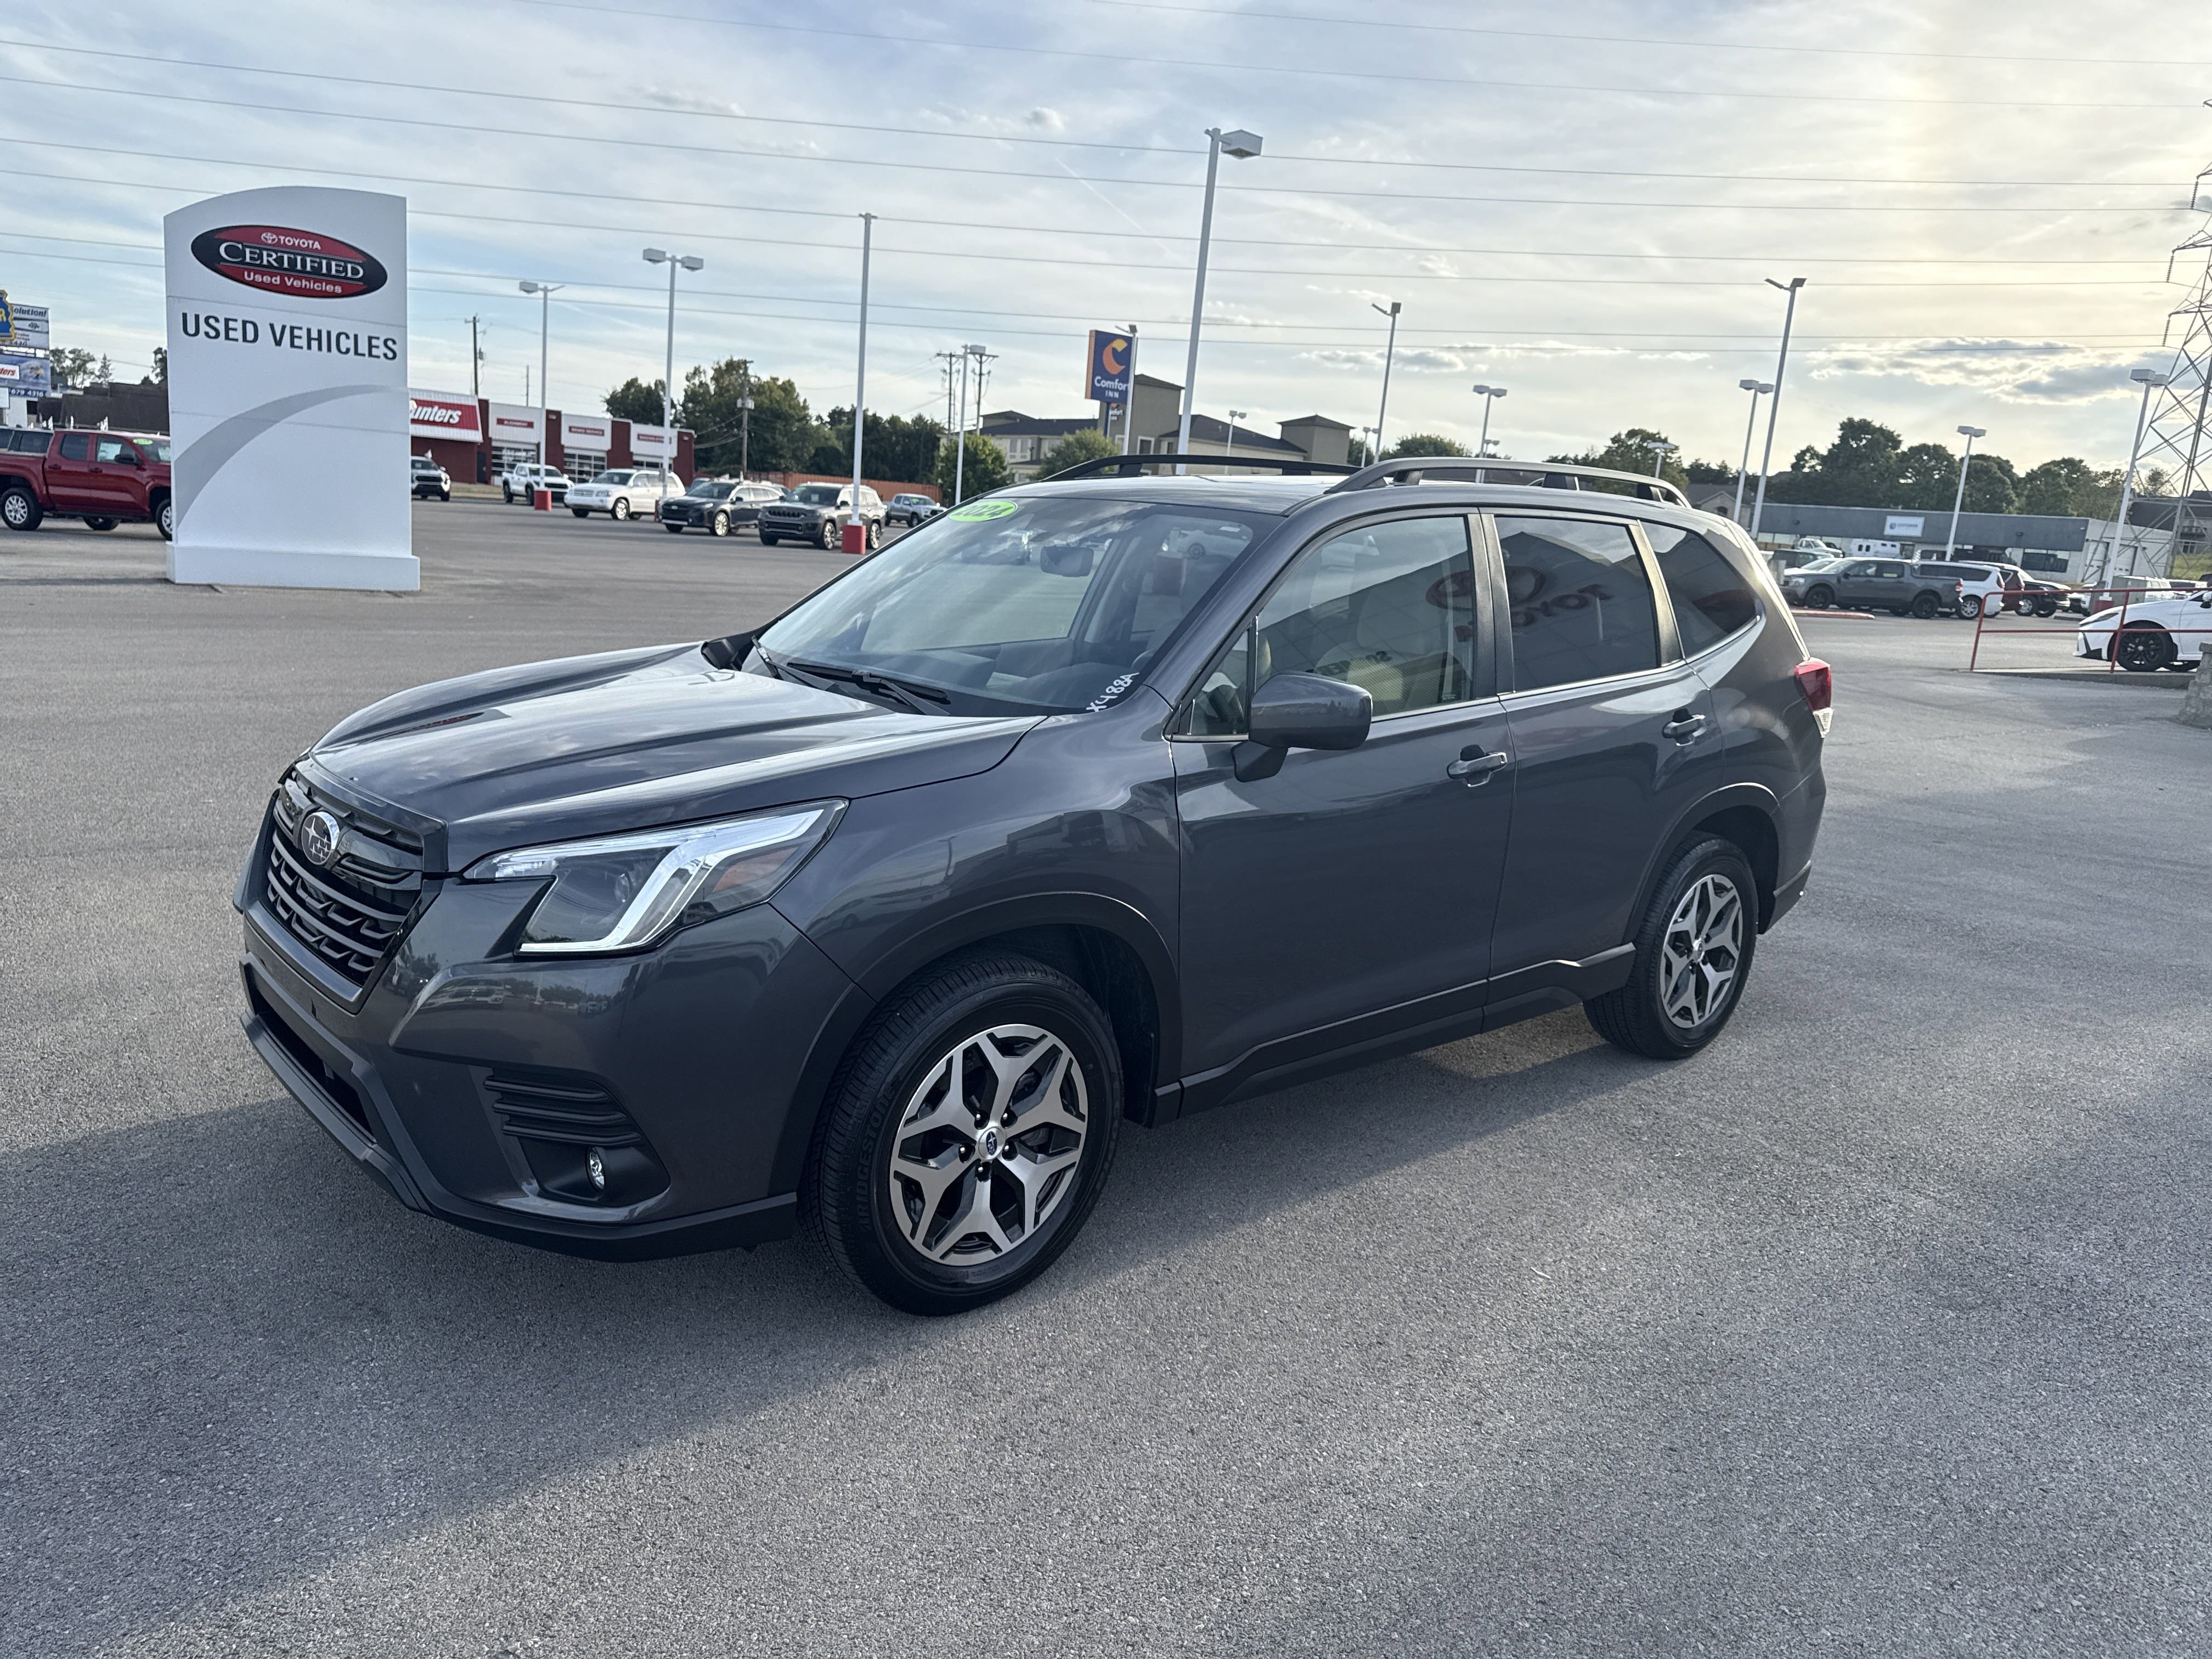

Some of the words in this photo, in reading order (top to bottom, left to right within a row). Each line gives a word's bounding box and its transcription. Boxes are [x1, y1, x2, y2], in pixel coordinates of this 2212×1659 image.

[278, 236, 321, 251] TOYOTA
[219, 241, 364, 279] CERTIFIED
[244, 271, 280, 285] Used
[284, 276, 342, 294] Vehicles
[14, 307, 47, 318] olution!
[182, 312, 259, 344] USED
[269, 323, 397, 361] VEHICLES
[1105, 390, 1119, 399] INN
[410, 405, 462, 425] unters
[952, 504, 1014, 518] 2024
